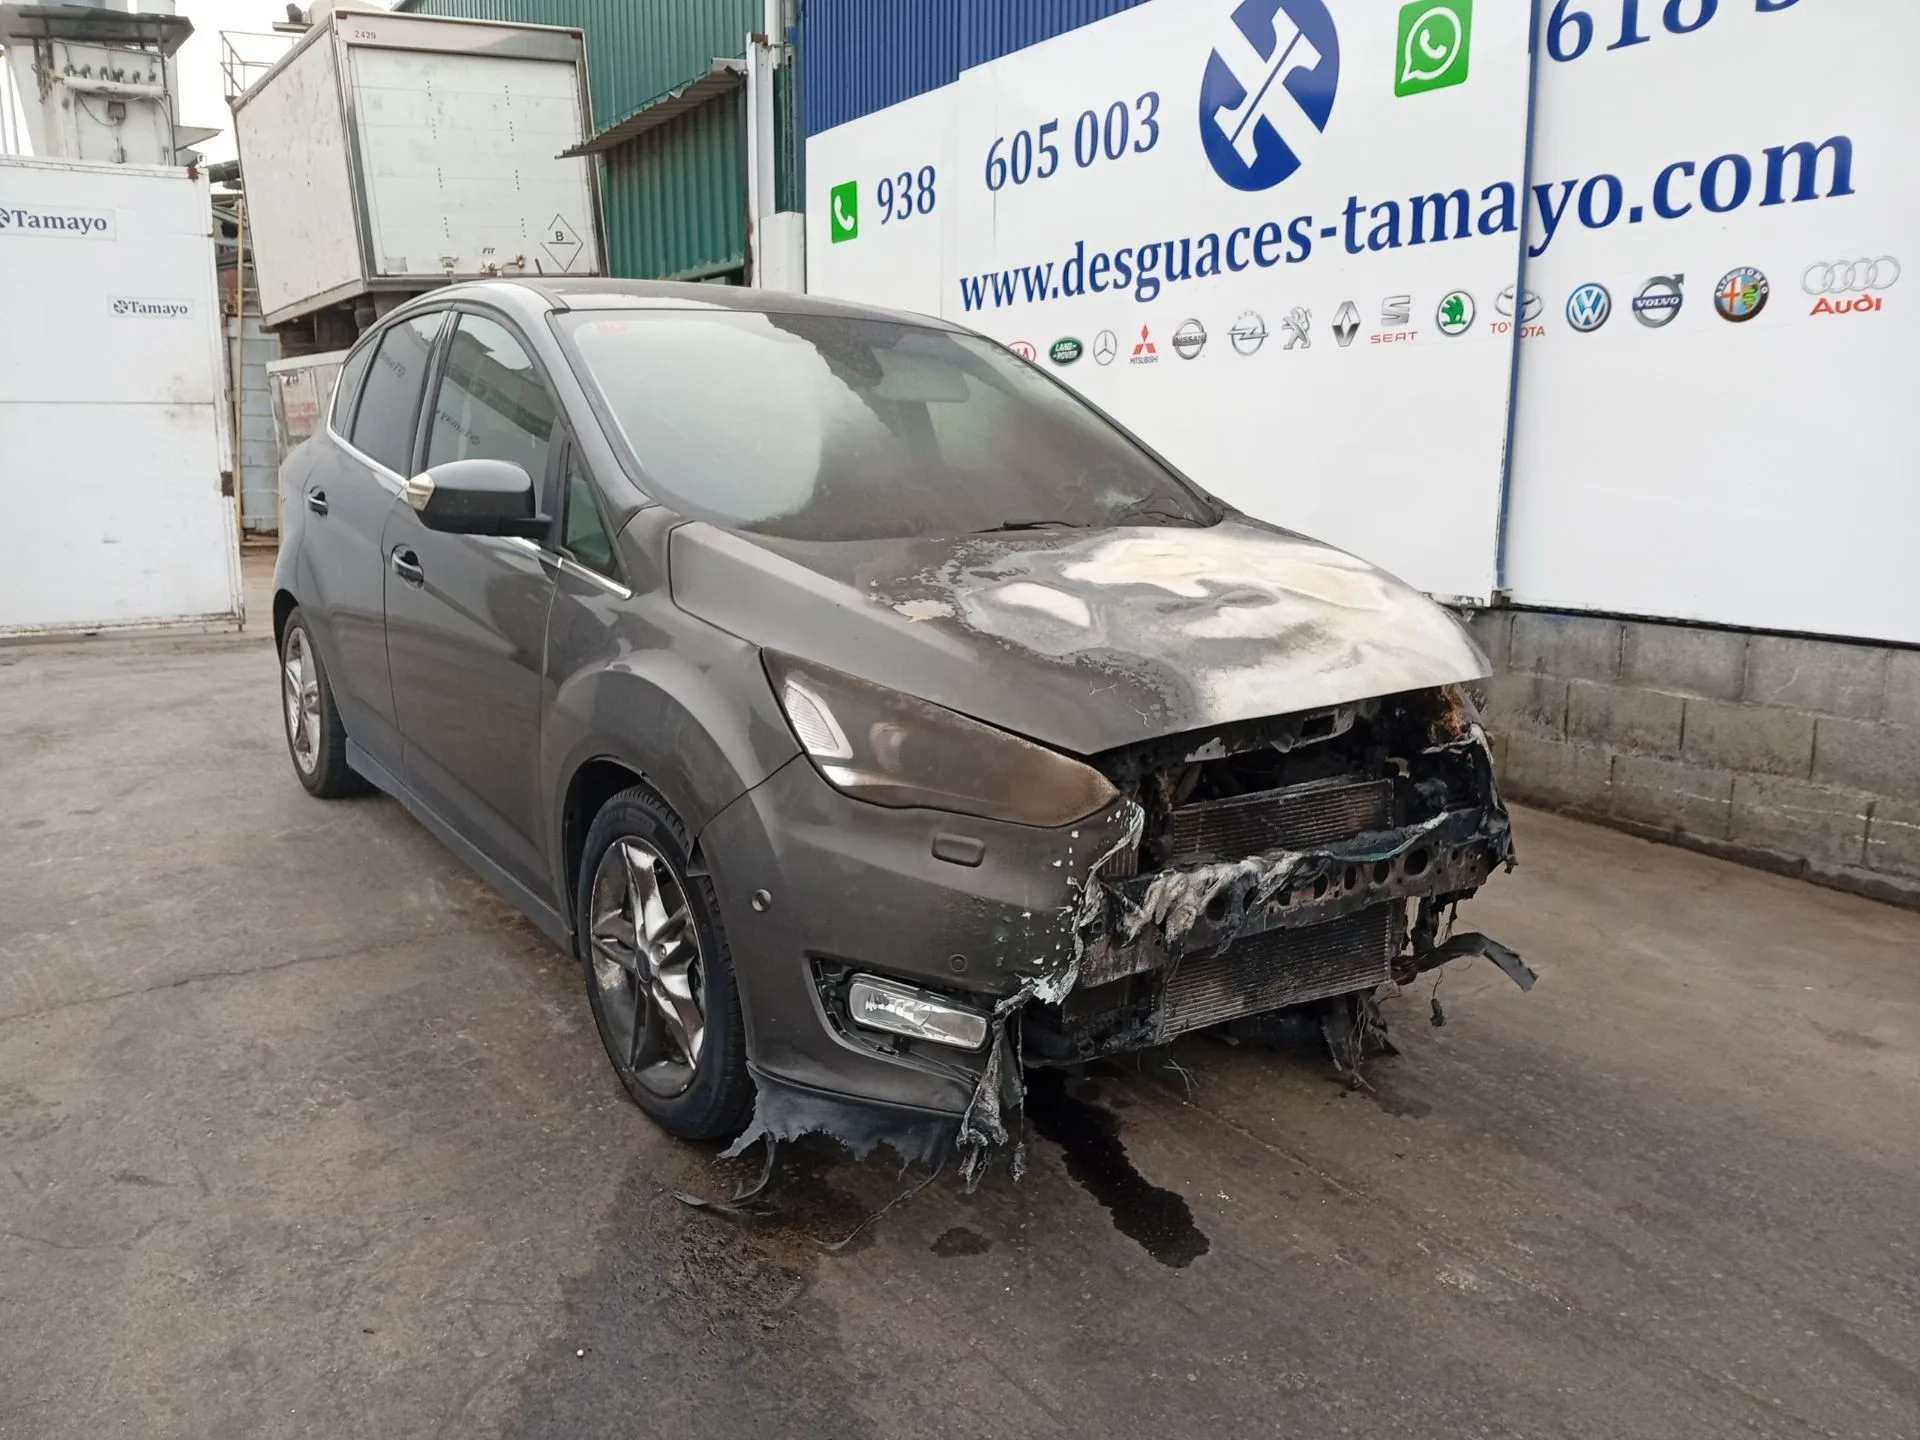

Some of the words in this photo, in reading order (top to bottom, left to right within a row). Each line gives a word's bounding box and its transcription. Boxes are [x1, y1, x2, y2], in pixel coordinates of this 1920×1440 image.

[354, 30, 377, 39] 2429
[877, 165, 936, 225] 938
[985, 117, 1059, 192] 605
[1074, 91, 1160, 169] 003
[11, 209, 108, 235] Tamayo
[959, 134, 1856, 312] www.desguaces-tamayo.com
[555, 231, 564, 241] B
[1740, 267, 1769, 294] ROMEO
[128, 300, 188, 318] Tamayo
[1635, 296, 1680, 308] VOLVO
[1809, 294, 1882, 316] Audi
[1175, 334, 1204, 343] NISSAN
[1370, 331, 1418, 344] SEAT
[1490, 320, 1546, 339] TOOTA
[1129, 355, 1158, 365] MITSUBISHI
